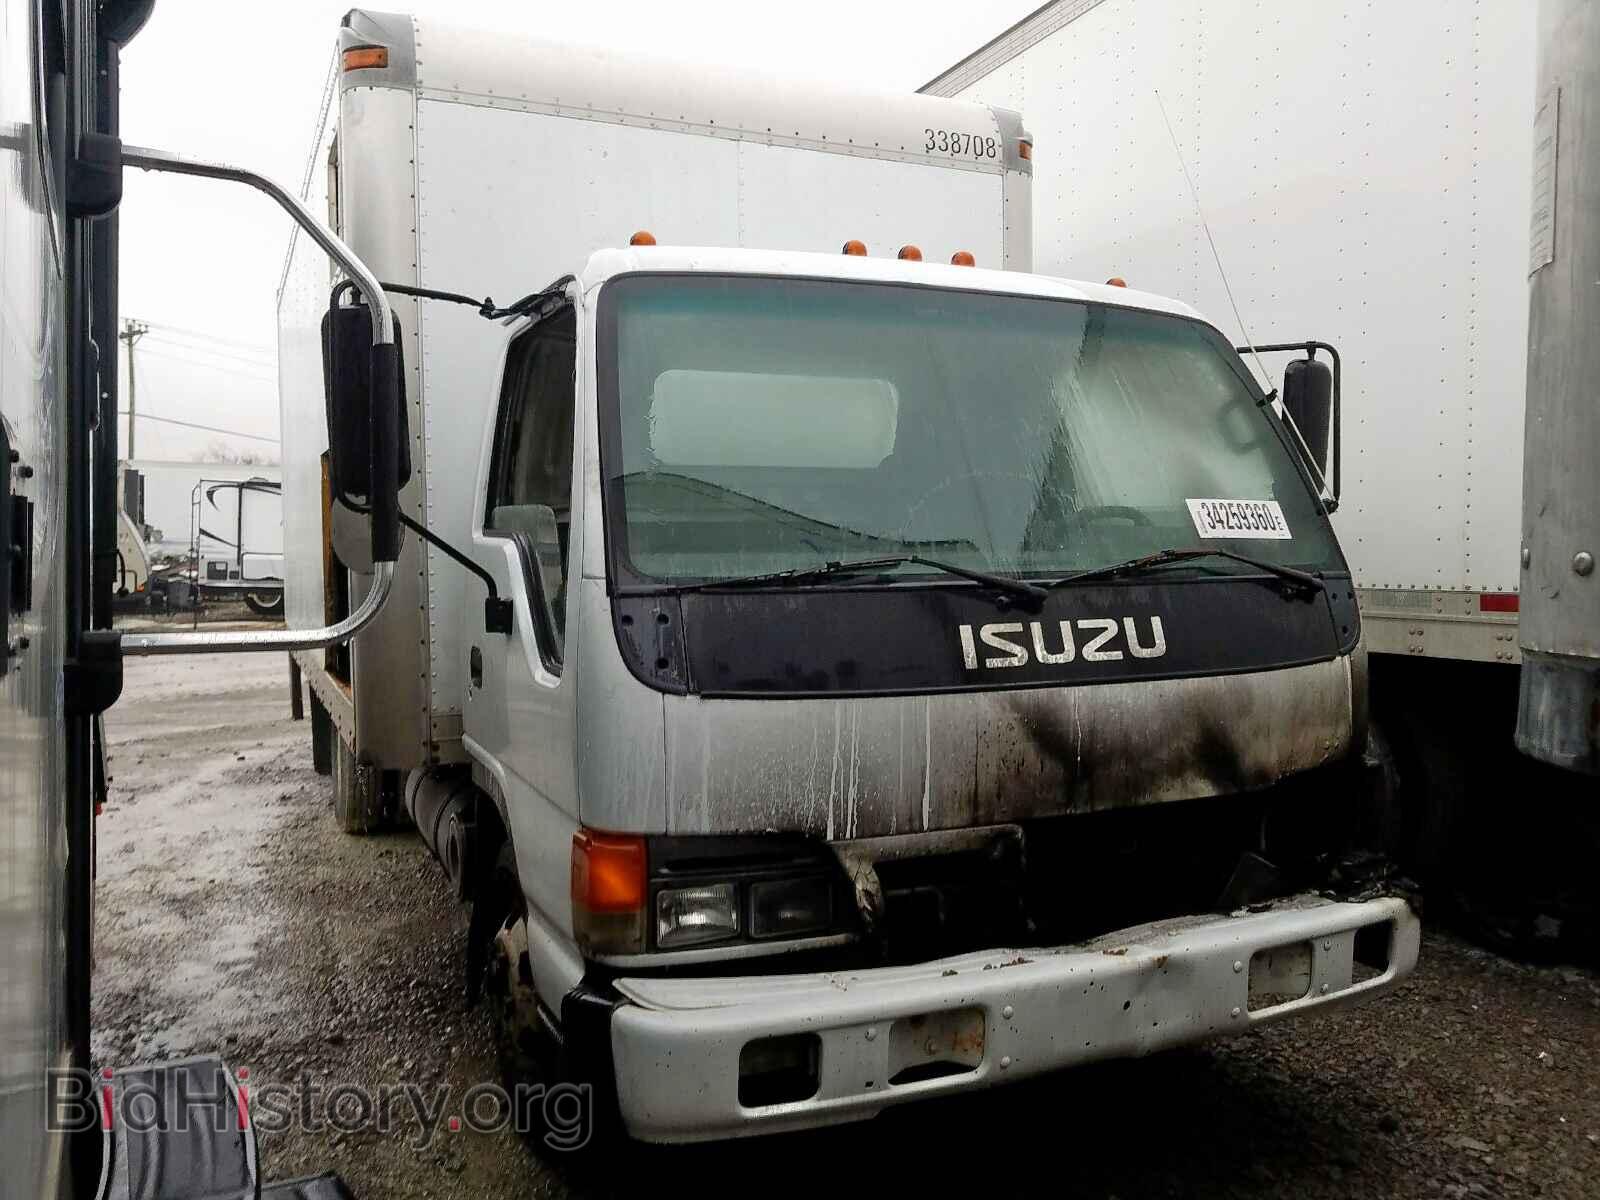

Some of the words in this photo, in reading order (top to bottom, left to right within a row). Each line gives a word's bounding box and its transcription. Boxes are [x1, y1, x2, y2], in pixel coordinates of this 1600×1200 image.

[924, 129, 996, 158] 338708
[1201, 502, 1277, 530] 34259360
[959, 616, 1167, 669] ISUZU
